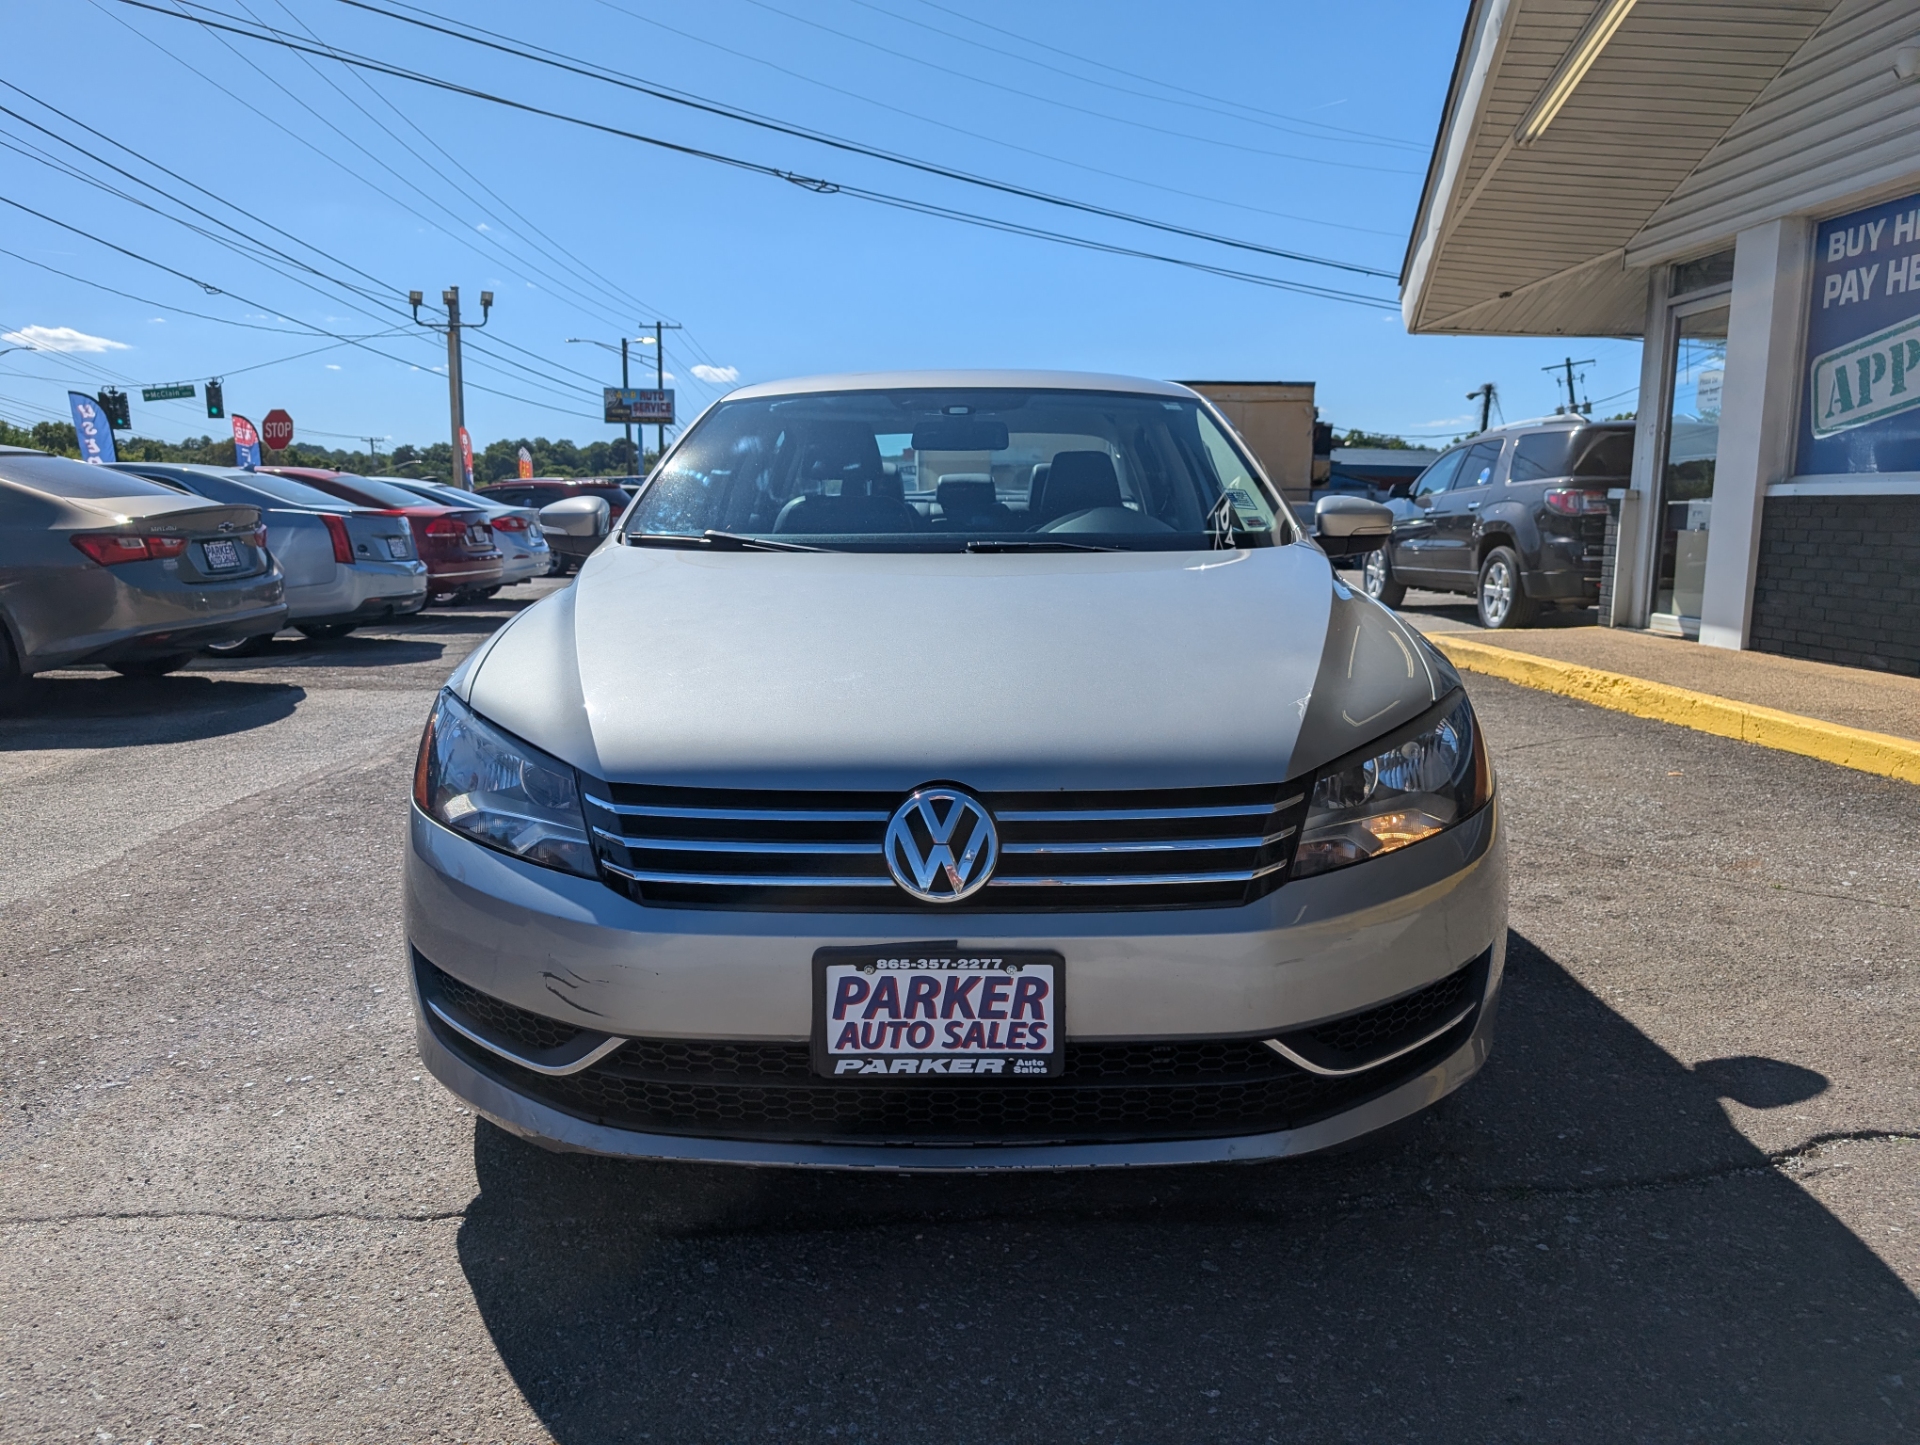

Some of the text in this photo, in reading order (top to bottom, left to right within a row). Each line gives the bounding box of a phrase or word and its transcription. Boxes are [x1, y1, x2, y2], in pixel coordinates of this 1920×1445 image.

[1827, 218, 1887, 263] BUY
[1823, 263, 1880, 309] PAY
[1824, 338, 1920, 418] APP
[150, 389, 180, 398] McClain
[640, 391, 664, 401] AUTO
[633, 402, 671, 412] SERVICE
[265, 422, 291, 438] STOP
[206, 545, 234, 555] PARKER
[876, 959, 1003, 970] 865-357-2277
[832, 975, 1049, 1020] PARKER
[834, 1020, 1048, 1050] AUTO SALES
[834, 1058, 1005, 1074] PARKER
[1013, 1066, 1048, 1074] Sales
